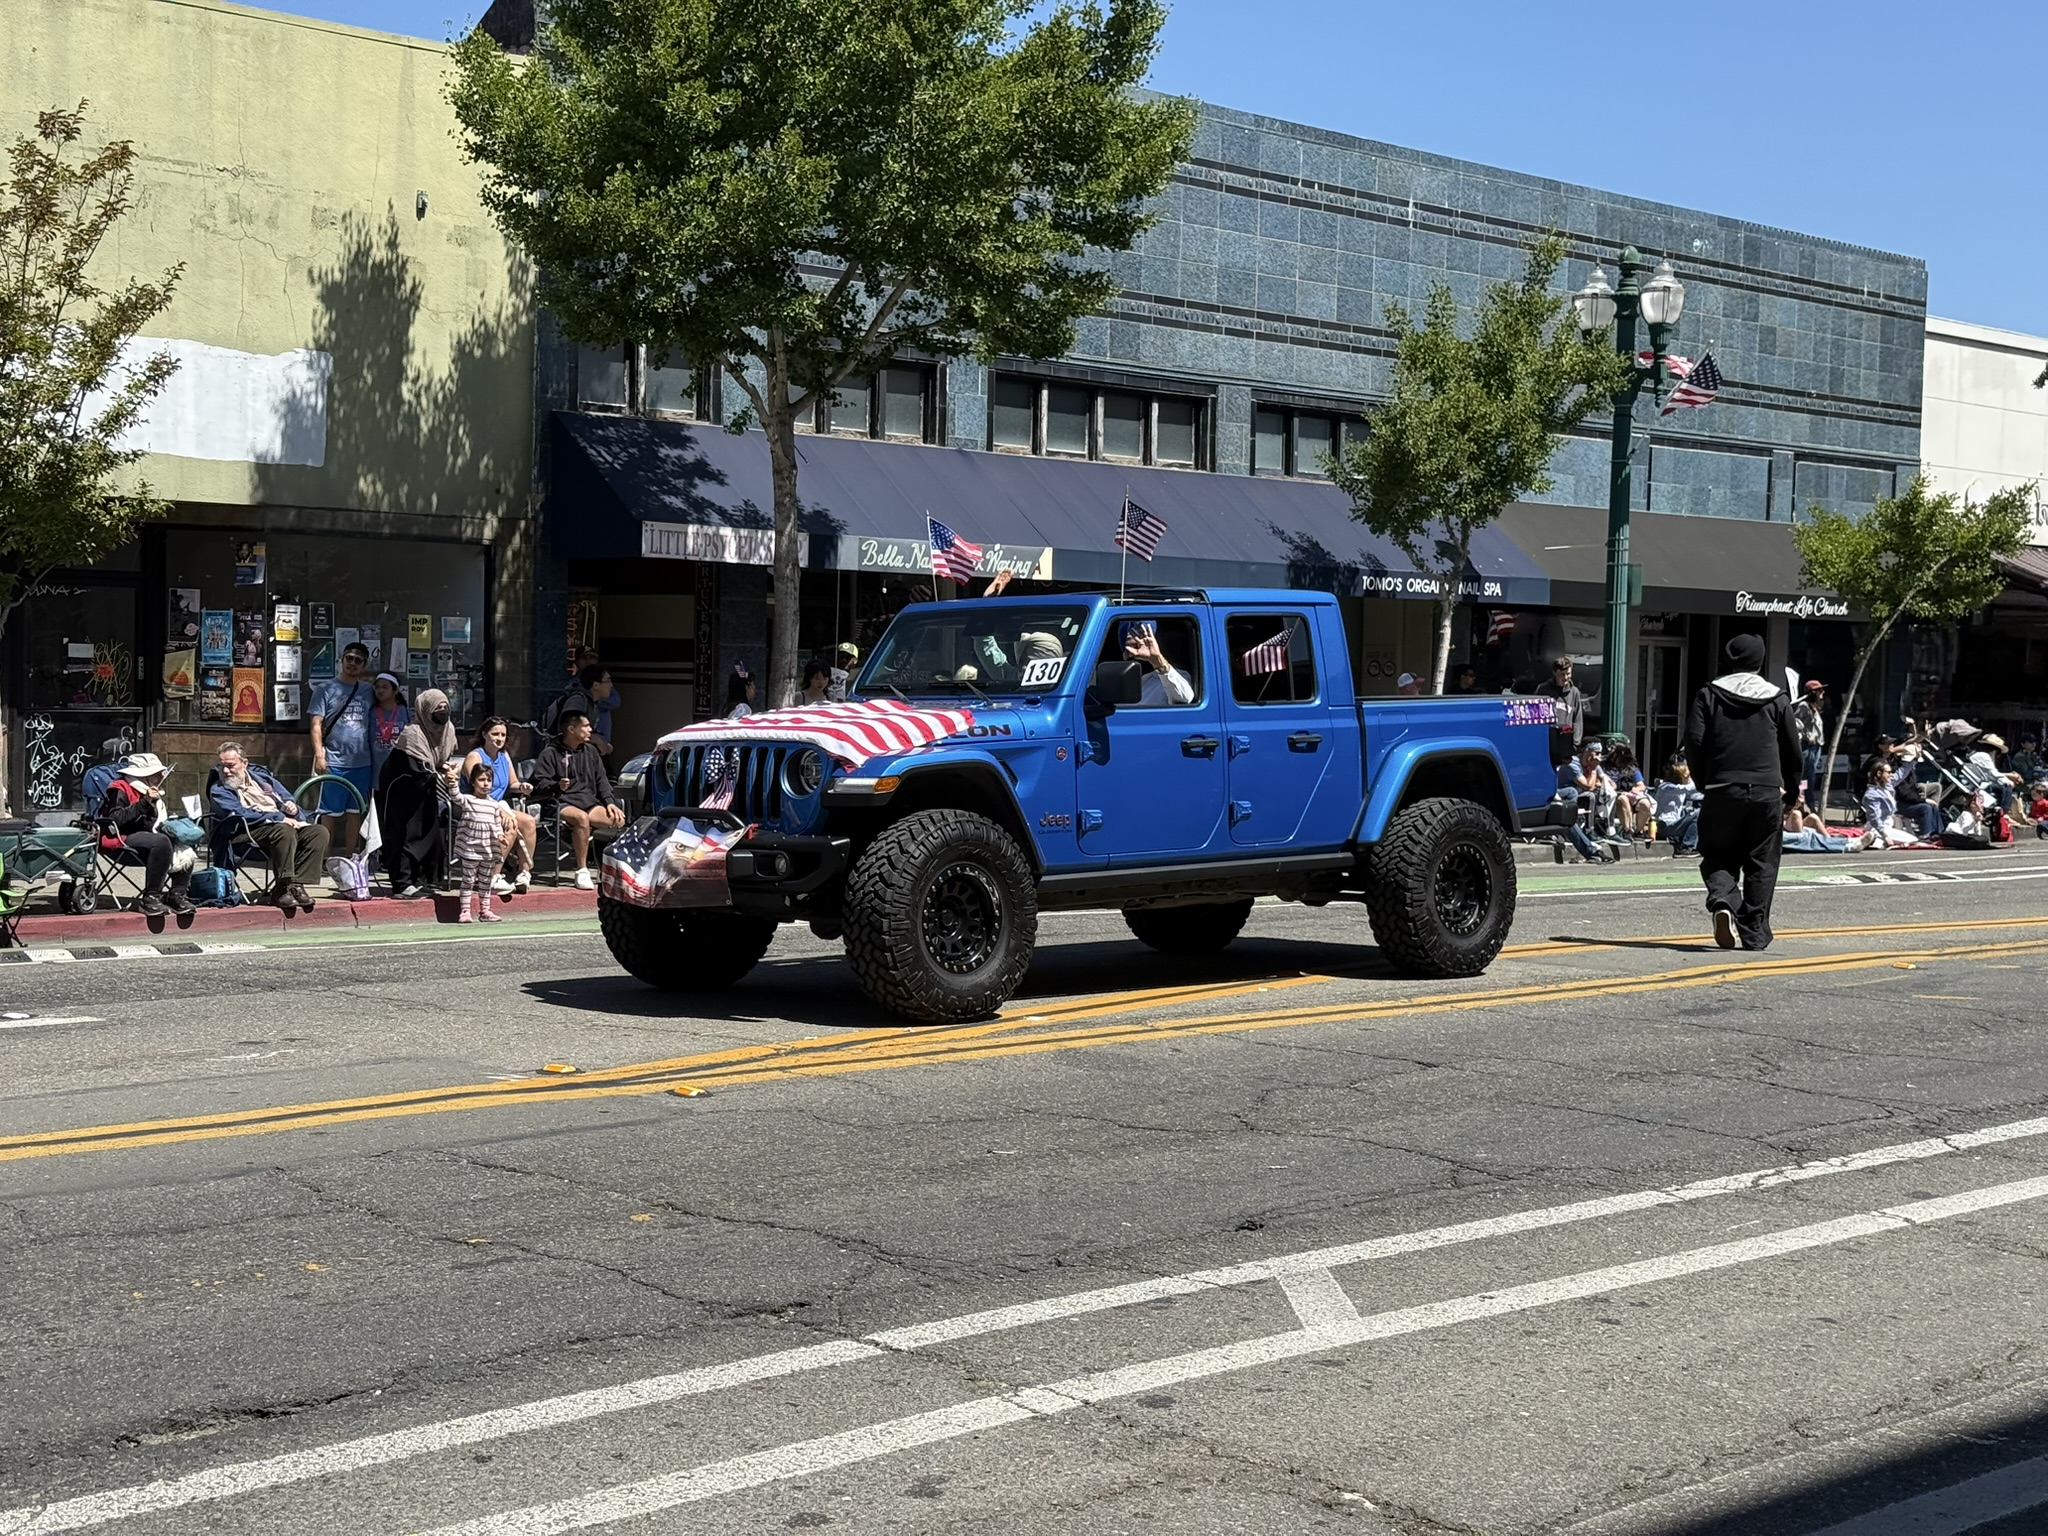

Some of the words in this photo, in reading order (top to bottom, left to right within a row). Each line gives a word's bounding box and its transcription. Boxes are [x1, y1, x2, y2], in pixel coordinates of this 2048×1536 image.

[649, 528, 700, 557] LITTLE
[861, 539, 904, 567] Bella
[699, 562, 711, 622] RTUNE
[1362, 575, 1403, 592] TOMO'S
[1458, 581, 1480, 596] NAIL
[1483, 582, 1502, 597] SPA
[1735, 590, 1793, 616] Triumphant
[1793, 595, 1813, 619] Life
[1813, 596, 1849, 617] Church
[411, 617, 428, 626] IMP
[1025, 661, 1062, 683] 130
[1513, 704, 1531, 720] USA
[1538, 702, 1555, 718] USA
[1039, 812, 1072, 829] Jeep
